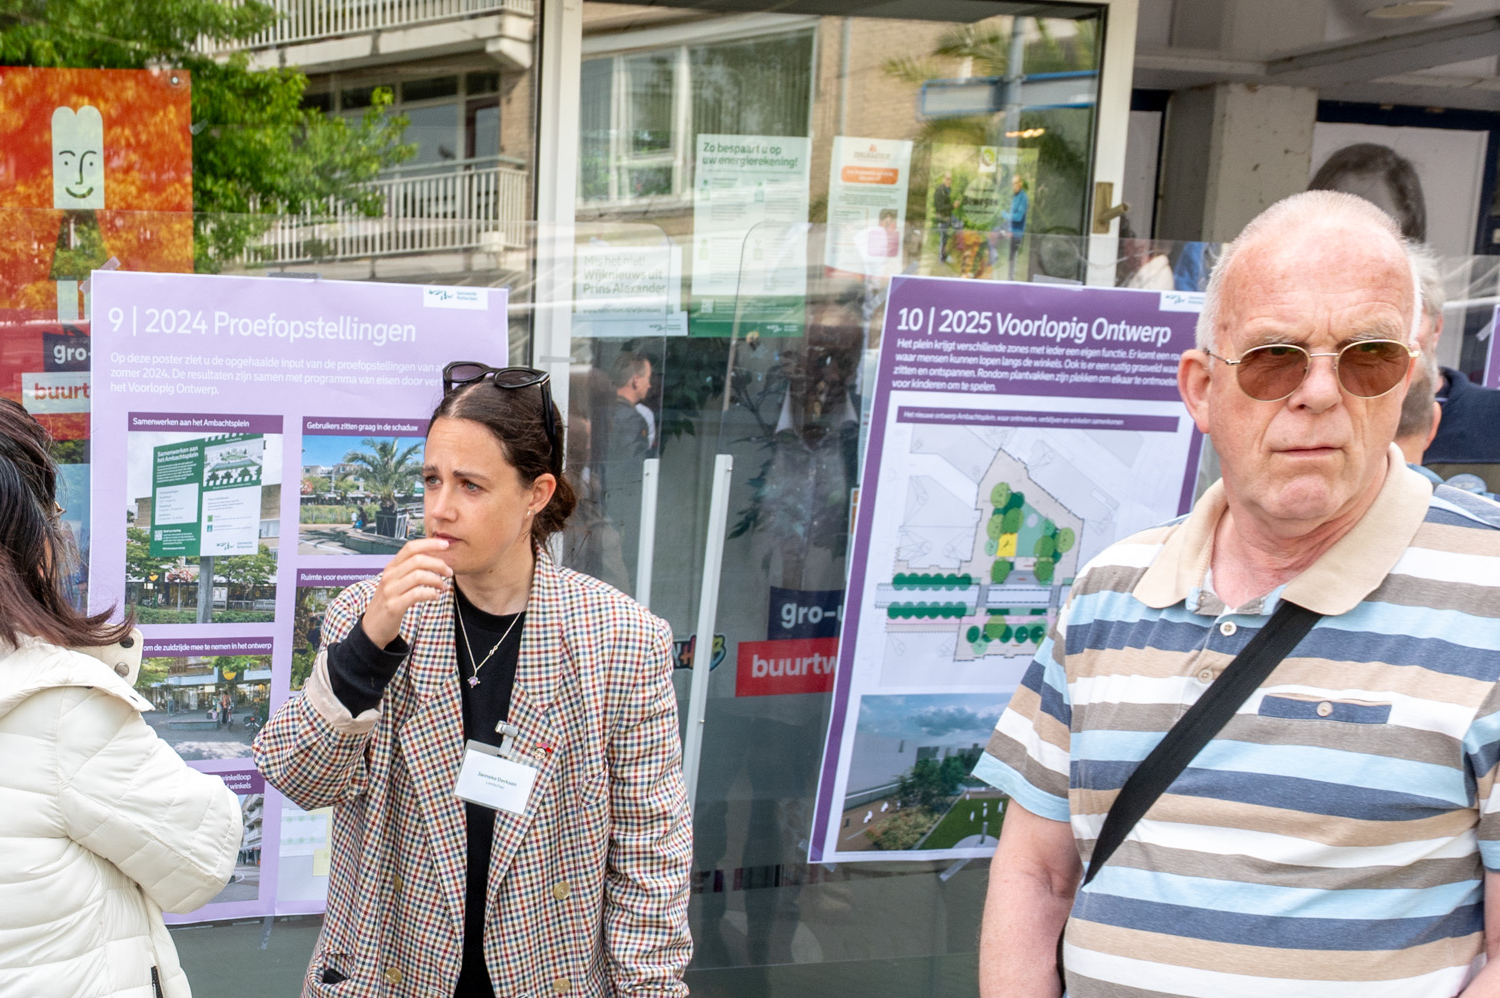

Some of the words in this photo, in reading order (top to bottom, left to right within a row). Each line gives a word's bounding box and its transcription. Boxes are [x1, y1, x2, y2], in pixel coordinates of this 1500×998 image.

[703, 142, 716, 153] Zo
[717, 142, 760, 155] bespaart
[761, 145, 768, 154] u
[769, 146, 782, 156] op
[702, 156, 717, 165] uw
[718, 156, 799, 169] energierekening!
[583, 256, 603, 266] Mis
[604, 255, 622, 266] het
[583, 269, 647, 282] Wijknieuws
[648, 269, 663, 280] uit
[583, 282, 611, 294] Prins
[108, 307, 124, 332] 9
[145, 308, 208, 335] 2024
[214, 310, 417, 347] Proefopstellingen
[897, 307, 924, 331] 10
[938, 309, 993, 334] 2025
[996, 311, 1089, 344] Voorlopig
[1091, 317, 1172, 347] Ontwerp
[897, 338, 912, 348] Het
[913, 339, 934, 350] plein
[934, 340, 956, 352] krijgt
[956, 341, 1006, 352] verschillende
[1007, 344, 1029, 353] zones
[1030, 346, 1045, 354] met
[1045, 346, 1065, 355] ieder
[1065, 348, 1079, 356] een
[1080, 348, 1101, 359] eigen
[1101, 348, 1128, 358] functie.
[1128, 349, 1137, 358] Er
[1137, 350, 1156, 360] komt
[1155, 352, 1171, 360] een
[110, 352, 126, 364] Op
[127, 352, 151, 364] deze
[152, 354, 183, 366] poster
[184, 354, 202, 365] ziet
[212, 355, 224, 365] de
[225, 356, 279, 369] opgehaalde
[282, 359, 305, 371] input
[306, 360, 322, 369] van
[323, 359, 336, 370] de
[337, 359, 416, 374] proefopstellingen
[417, 363, 434, 372] van
[895, 353, 917, 362] waar
[917, 354, 949, 363] mensen
[949, 354, 979, 364] kunnen
[979, 355, 1001, 366] lopen
[1001, 356, 1022, 368] langs
[1023, 357, 1033, 367] de
[1033, 358, 1063, 369] winkels.
[1064, 359, 1080, 369] Ook
[1096, 362, 1110, 371] een
[1110, 362, 1132, 373] rustig
[1131, 363, 1163, 374] grasveld
[110, 369, 141, 378] zomer
[142, 368, 171, 379] 2024.
[172, 369, 186, 379] De
[187, 370, 234, 381] resultaten
[235, 371, 252, 383] zijn
[253, 373, 284, 382] samen
[285, 373, 303, 383] met
[304, 375, 357, 387] programma
[359, 376, 375, 385] van
[376, 375, 401, 386] eisen
[402, 375, 424, 387] door
[893, 365, 917, 375] zitten
[929, 367, 977, 378] ontspannen.
[977, 368, 1009, 379] Rondom
[1009, 369, 1055, 382] plantvakken
[1055, 372, 1070, 383] zijn
[1069, 372, 1099, 384] plekken
[1099, 375, 1111, 383] om
[1111, 374, 1134, 385] elkaar
[34, 382, 90, 401] buurt
[110, 382, 127, 392] het
[128, 382, 175, 396] Voorlopig
[176, 383, 220, 397] Ontwerp.
[891, 379, 911, 389] voor
[911, 379, 947, 390] kinderen
[947, 382, 960, 390] om
[969, 381, 997, 392] spelen.
[133, 417, 179, 426] Samenwerken
[179, 419, 192, 427] aan
[192, 418, 203, 427] het
[203, 418, 250, 429] Ambachtsplein
[307, 421, 340, 430] Gebruikers
[341, 422, 357, 431] zitten
[358, 424, 377, 432] graag
[383, 423, 391, 431] de
[391, 424, 419, 432] schaduw
[300, 573, 323, 581] Ruimte
[780, 601, 843, 629] gro-
[154, 644, 162, 652] de
[162, 643, 190, 653] zuidzijde
[190, 644, 204, 652] mee
[237, 642, 248, 650] het
[247, 642, 273, 651] ontwerp
[751, 652, 838, 679] buurtw
